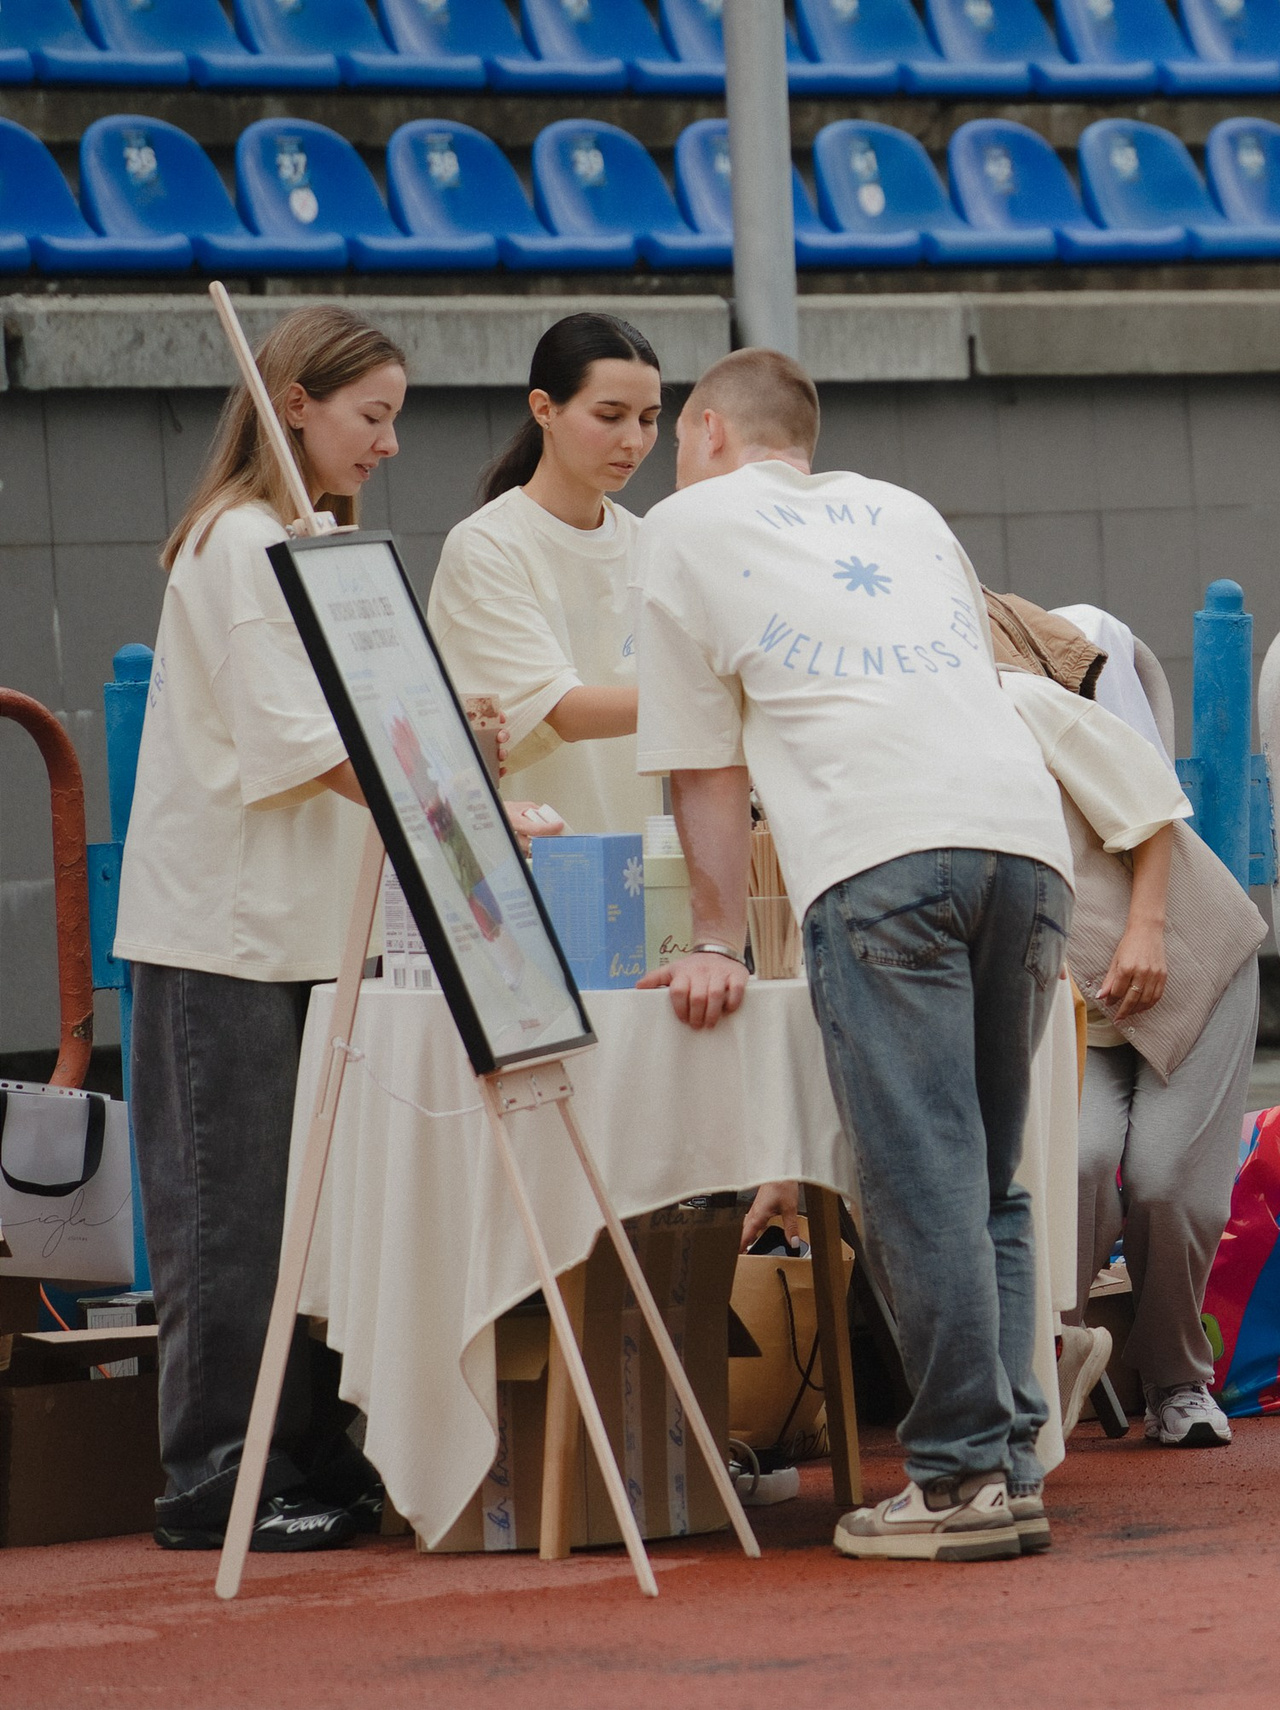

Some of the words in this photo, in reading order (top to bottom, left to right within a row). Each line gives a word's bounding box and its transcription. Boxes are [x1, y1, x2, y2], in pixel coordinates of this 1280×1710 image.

[755, 504, 806, 530] IN
[825, 504, 882, 526] MY
[758, 613, 961, 677] WELLNESS
